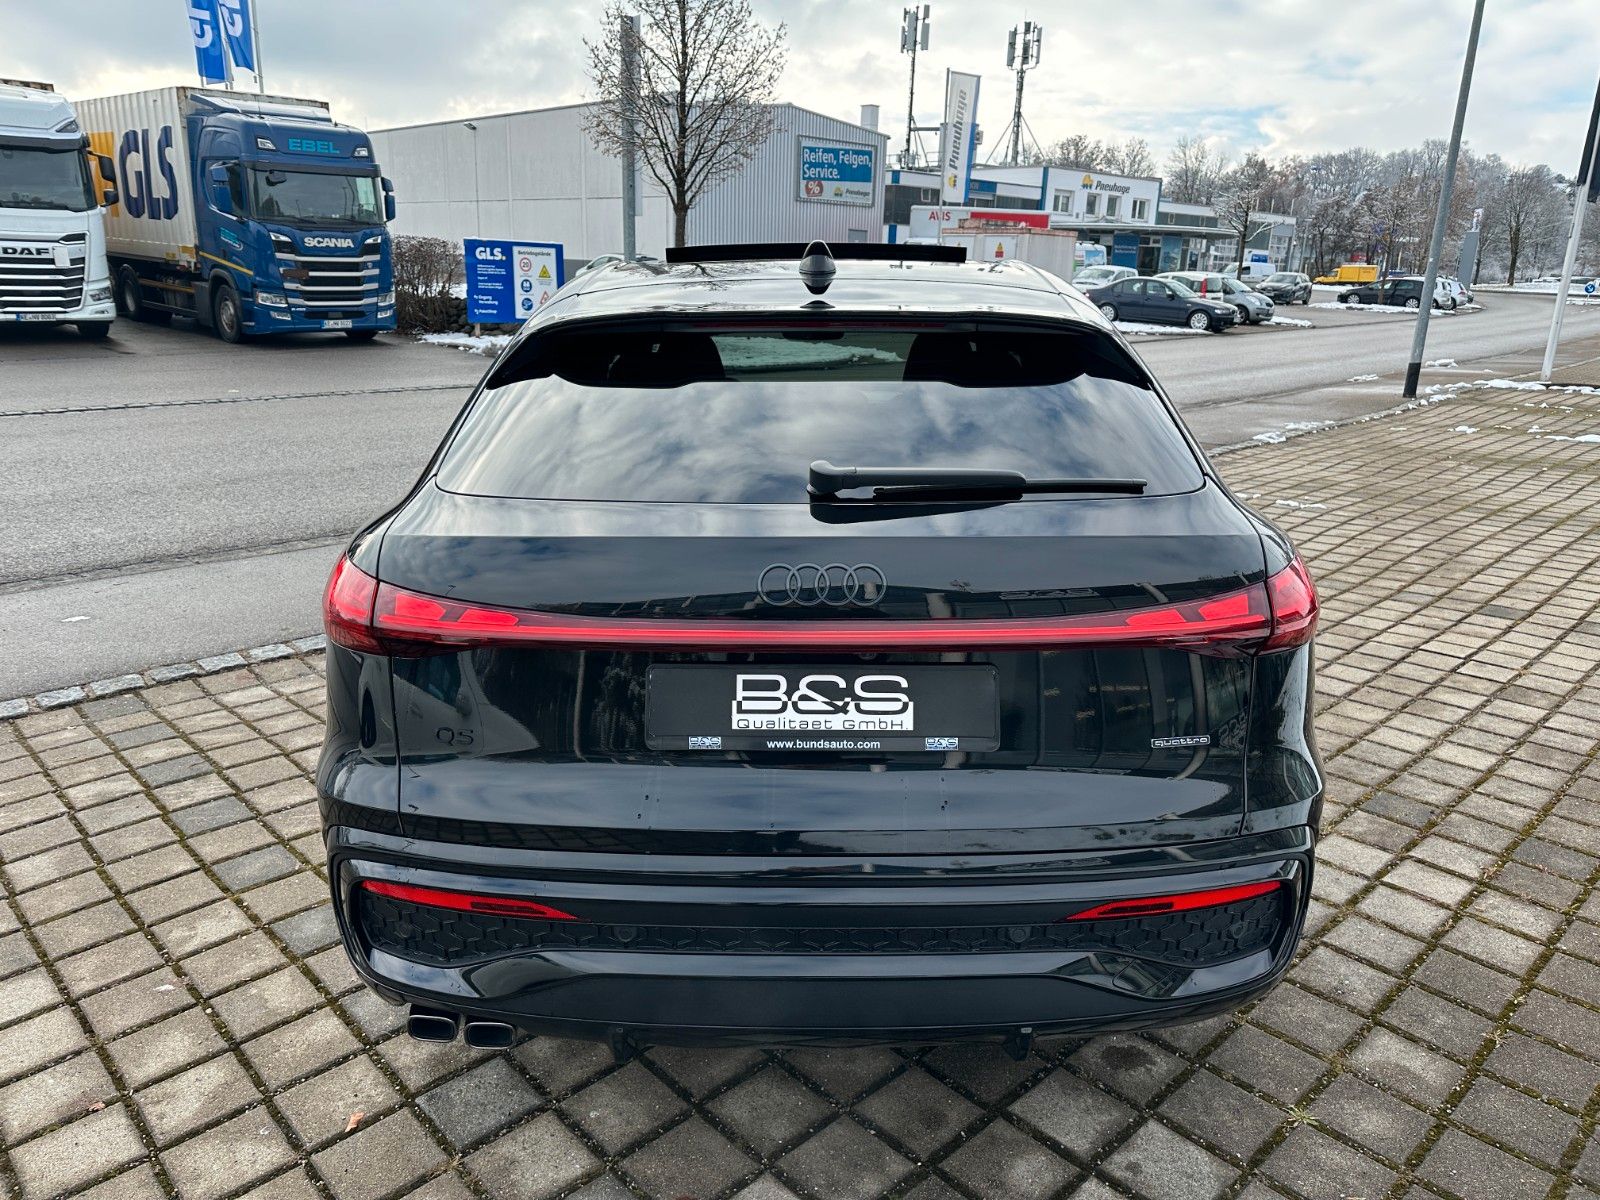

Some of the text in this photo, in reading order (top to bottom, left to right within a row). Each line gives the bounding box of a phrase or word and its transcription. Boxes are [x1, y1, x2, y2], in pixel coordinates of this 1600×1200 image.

[948, 89, 968, 172] Pneuhage
[288, 138, 340, 154] EBEL
[803, 149, 872, 168] Reifen, Felgen,
[119, 125, 179, 220] GLS
[803, 164, 840, 179] Service.
[1095, 180, 1131, 195] Pneuhage
[304, 237, 355, 248] SCANIA
[1, 246, 50, 256] DAF
[736, 674, 910, 716] B&S
[736, 717, 833, 730] Qualitaet
[766, 739, 881, 750] www.bundsauto.com
[1154, 737, 1208, 747] quattro
